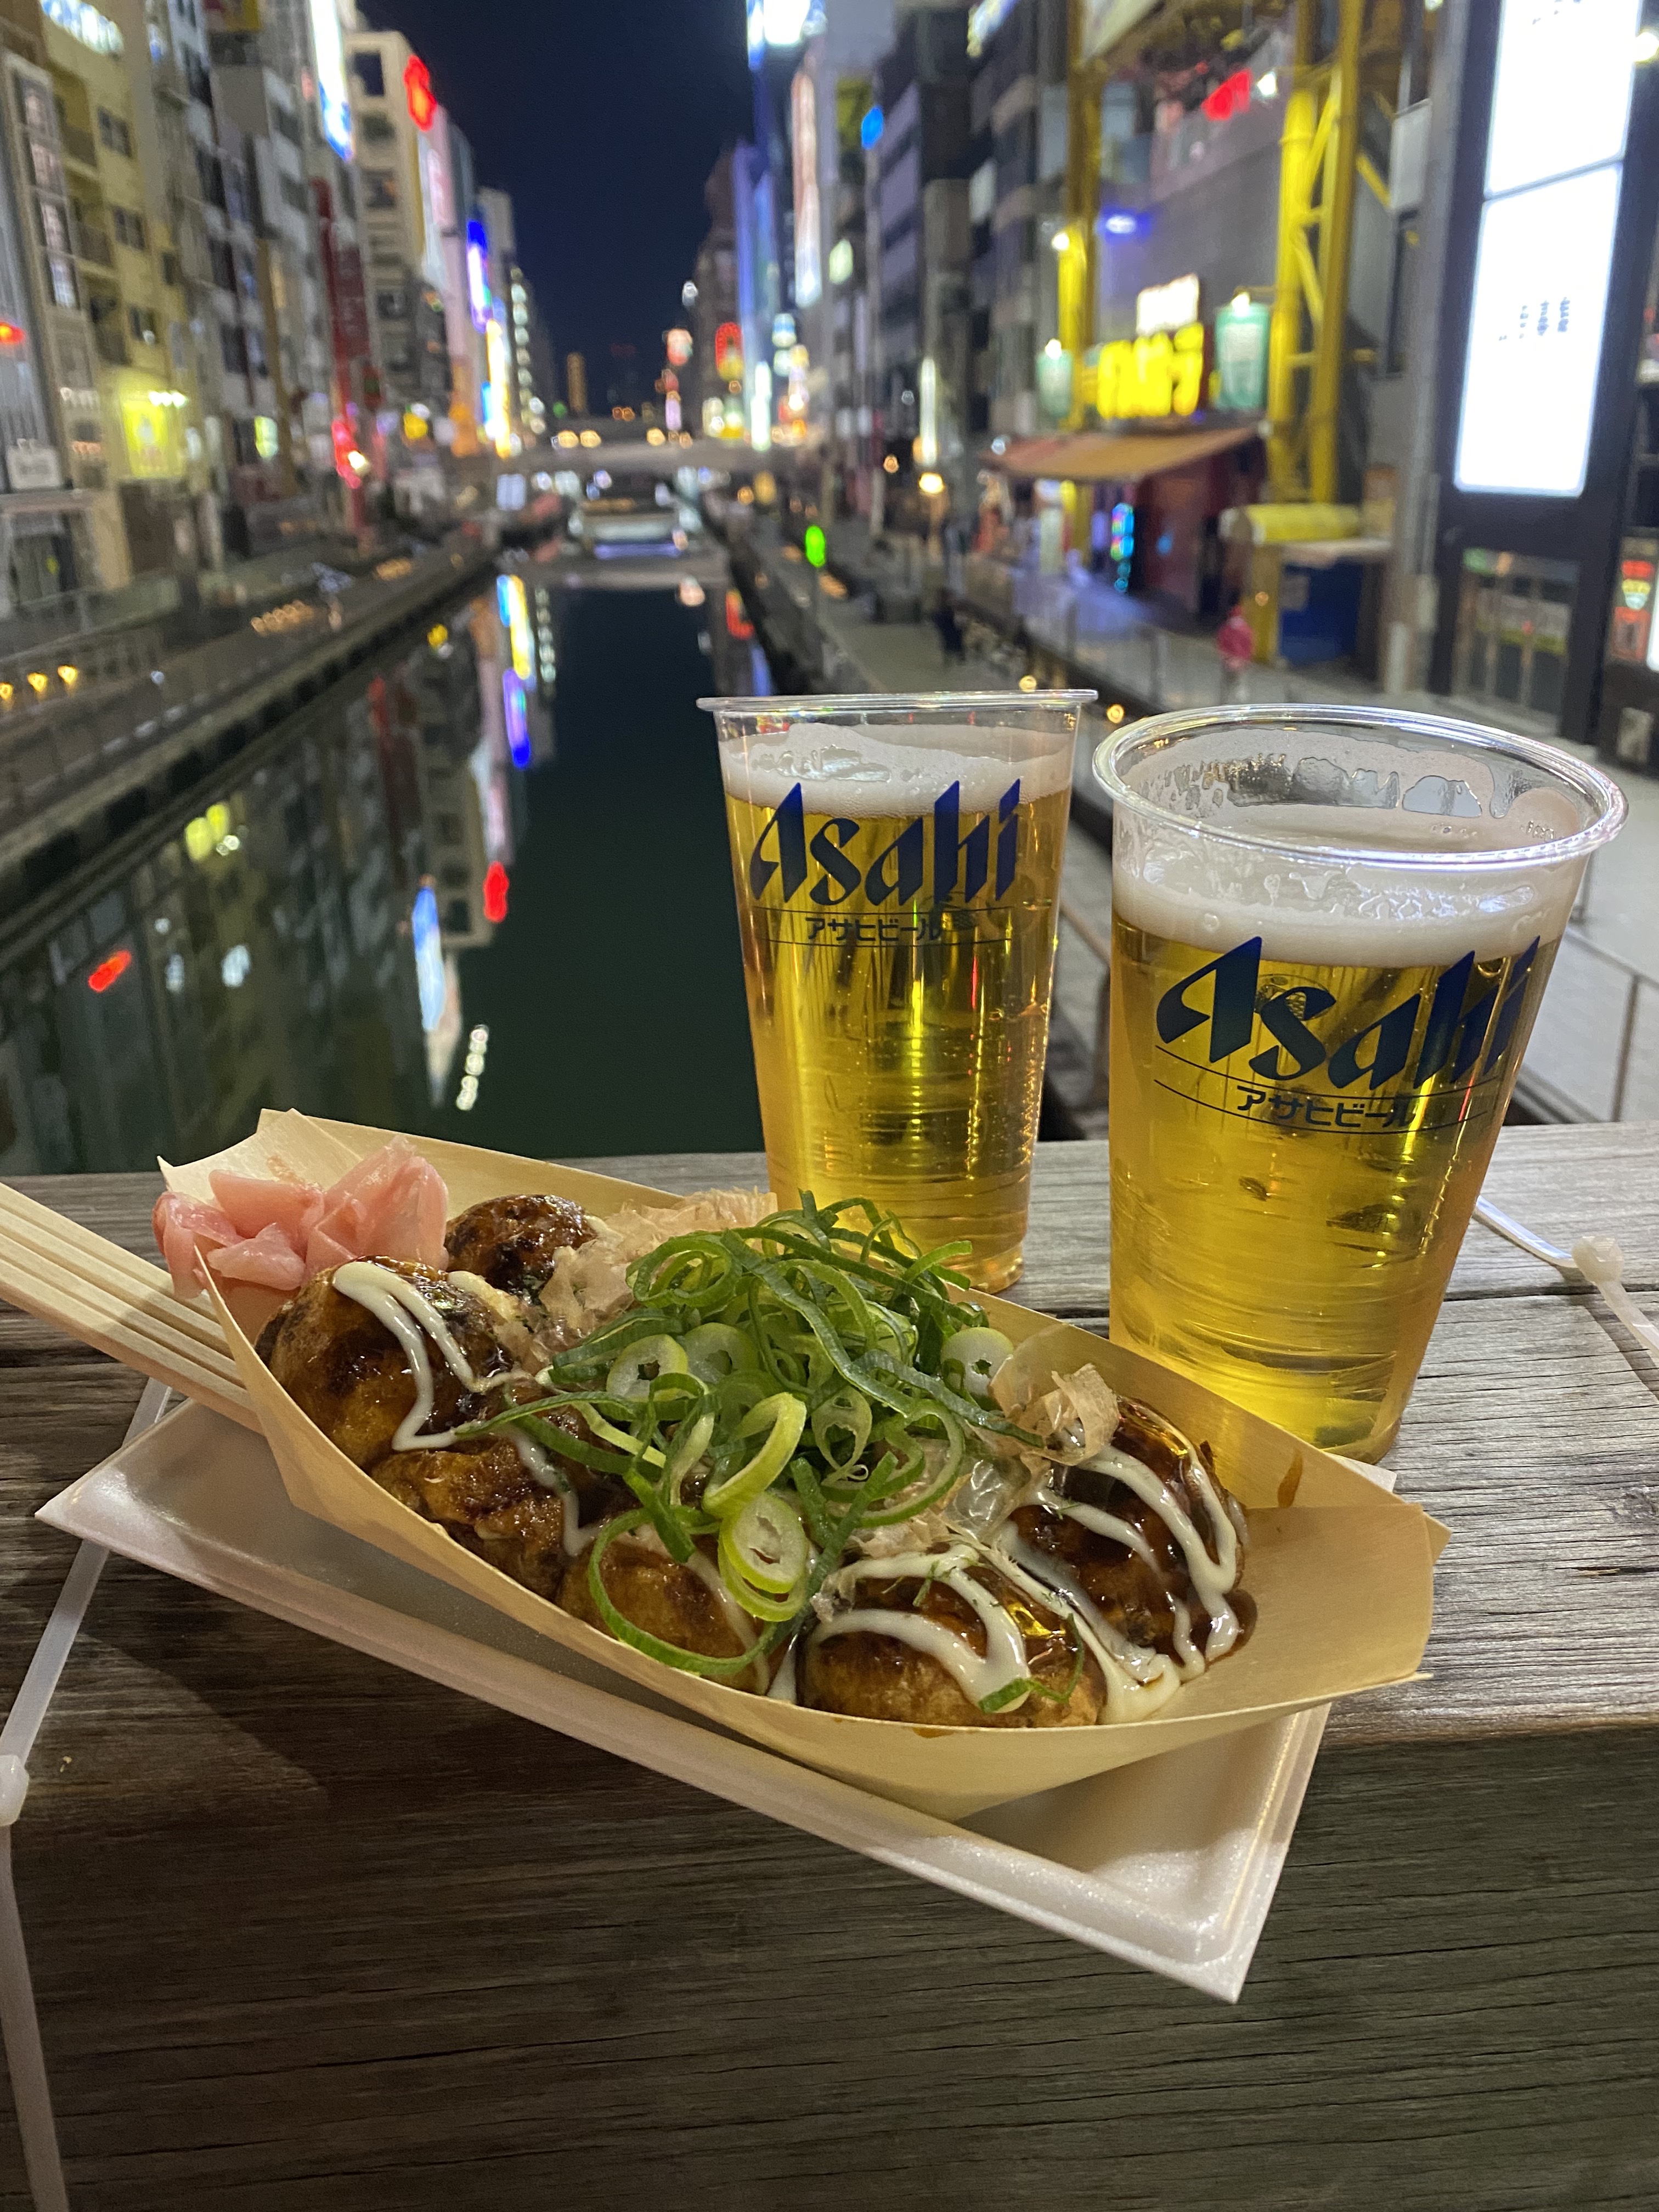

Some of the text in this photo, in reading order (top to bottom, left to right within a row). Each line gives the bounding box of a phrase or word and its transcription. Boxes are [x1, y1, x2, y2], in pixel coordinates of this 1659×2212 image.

[749, 778, 1020, 906] Asahi
[805, 917, 943, 941] アサヒビール
[1156, 935, 1541, 1091] Asahi
[1237, 1085, 1415, 1128] アサヒビール
